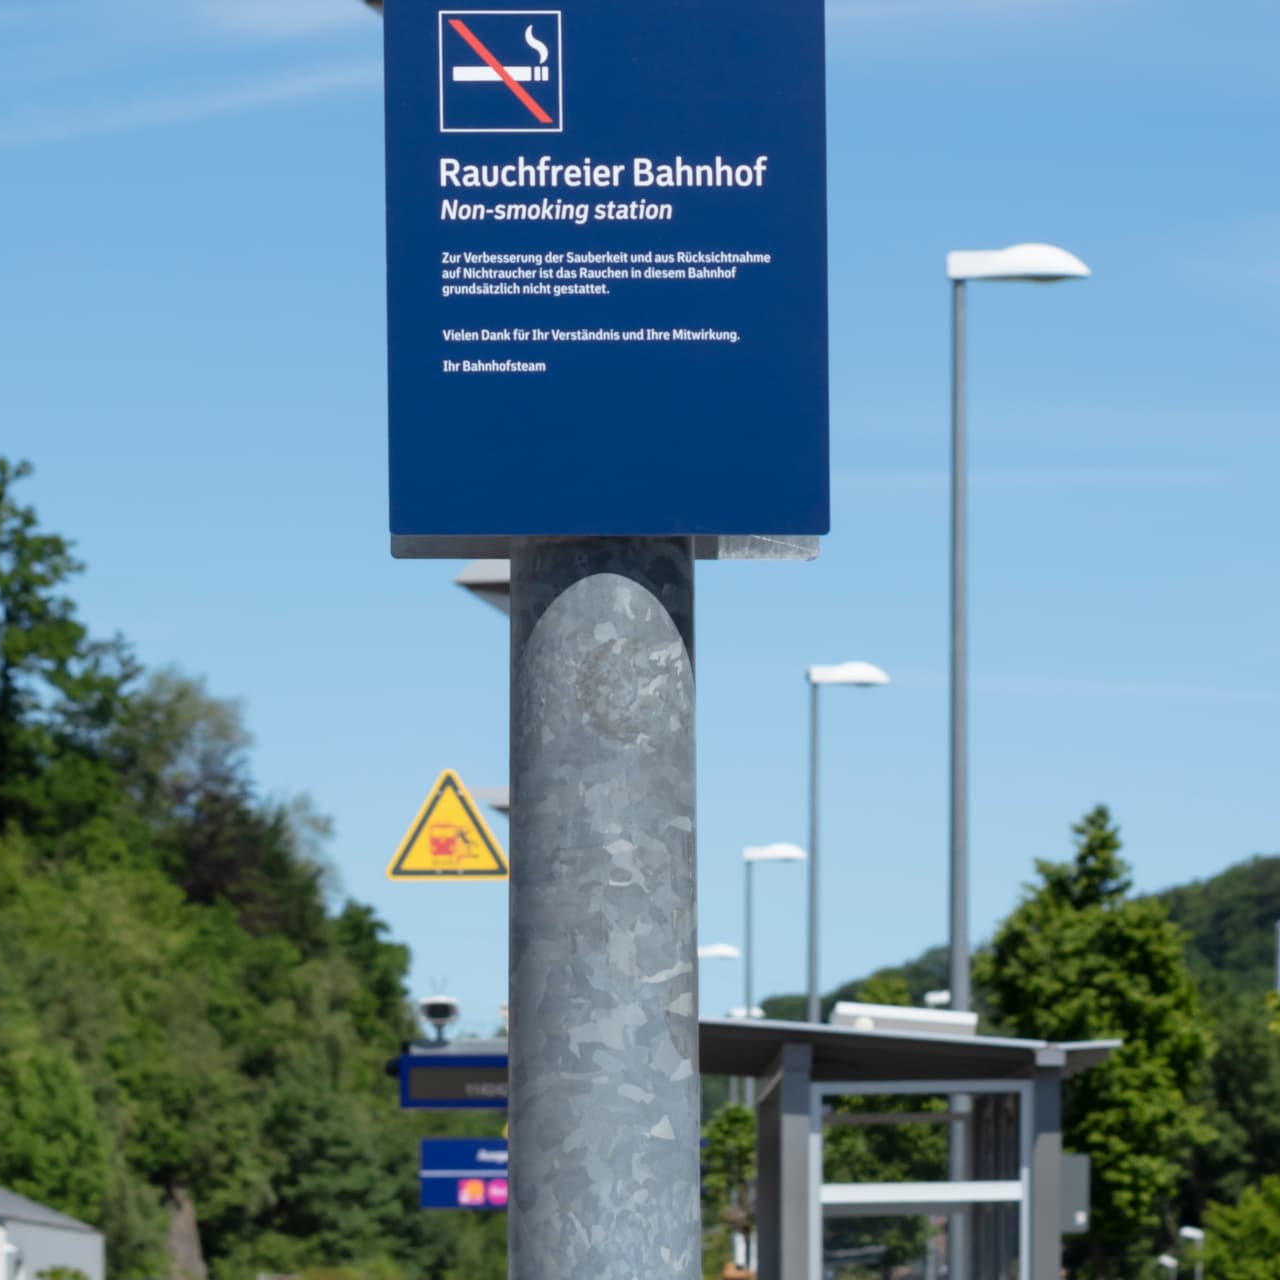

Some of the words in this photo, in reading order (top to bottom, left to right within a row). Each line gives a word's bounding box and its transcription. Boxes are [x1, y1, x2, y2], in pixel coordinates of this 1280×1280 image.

[439, 155, 625, 188] Rauchfreier
[633, 155, 768, 187] Bahnhof
[440, 197, 589, 225] Non-smoking
[594, 198, 673, 221] station
[442, 252, 461, 264] Zur
[463, 251, 543, 266] Verbesserung
[544, 251, 564, 264] der
[566, 251, 628, 264] Sauberkeit
[630, 251, 653, 263] und
[654, 253, 675, 263] aus
[677, 251, 771, 263] Rücksichtnahme
[441, 266, 461, 279] auf
[463, 266, 537, 279] Nichtraucher
[539, 267, 554, 279] ist
[555, 266, 577, 279] das
[579, 266, 629, 279] Rauchen
[630, 267, 642, 279] in
[644, 266, 686, 279] diesem
[687, 266, 737, 279] Bahnhof
[442, 282, 521, 297] grundsätzlich
[522, 282, 551, 295] nicht
[553, 283, 610, 297] gestattet.
[442, 329, 479, 341] Vielen
[481, 328, 511, 341] Dank
[512, 328, 530, 341] für
[532, 328, 549, 341] Ihr
[551, 328, 621, 341] Verständnis
[622, 328, 644, 341] und
[646, 328, 671, 341] Ihre
[672, 328, 740, 343] Mitwirkung.
[443, 360, 461, 372] Ihr
[462, 359, 546, 372] Bahnhofsteam
